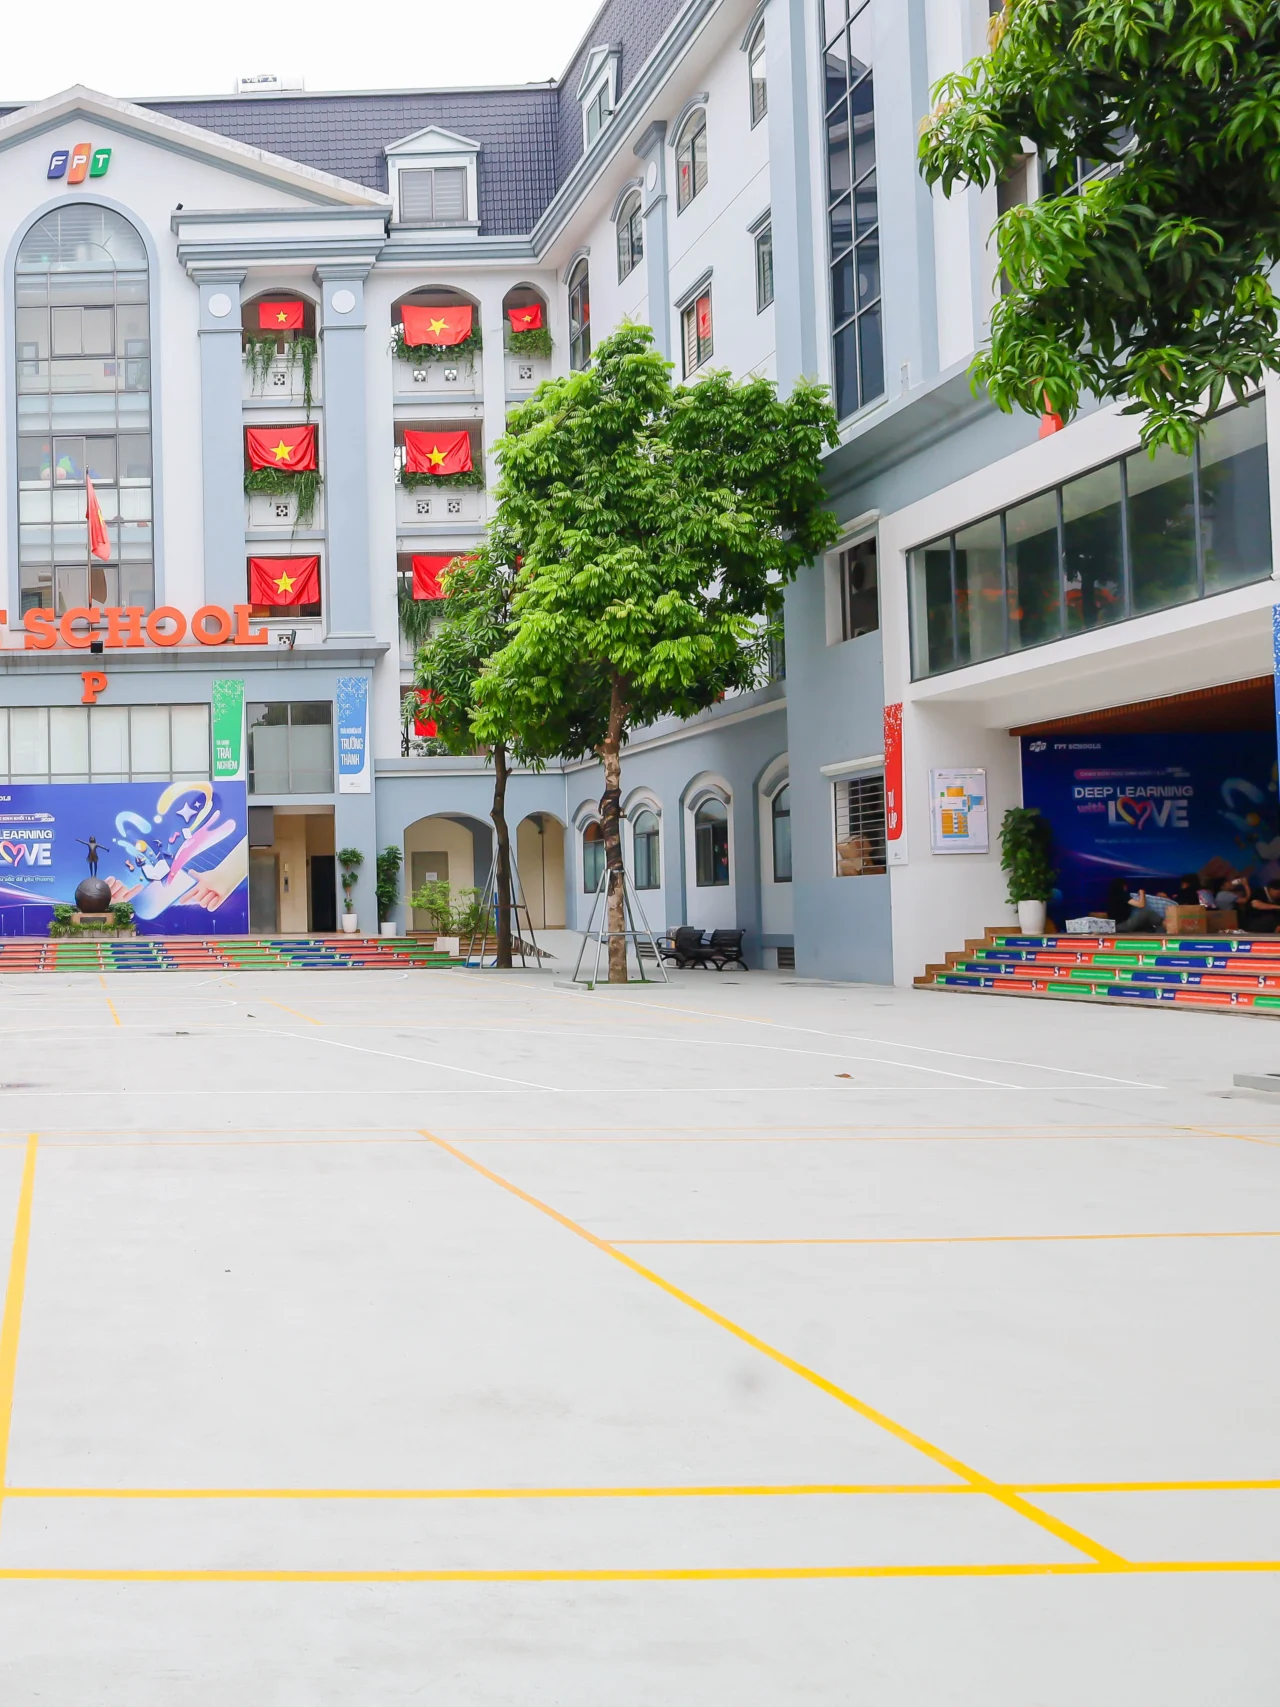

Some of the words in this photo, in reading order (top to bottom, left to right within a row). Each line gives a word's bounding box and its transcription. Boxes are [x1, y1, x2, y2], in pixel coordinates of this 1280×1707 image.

[24, 604, 268, 650] SCHOOL
[81, 671, 107, 703] P
[341, 752, 359, 765] THÀNH
[1074, 787, 1113, 798] DEEP
[1117, 786, 1193, 797] LEARNING
[1077, 801, 1106, 813] with
[1098, 940, 1103, 948] 5
[1076, 953, 1081, 962] 5
[1054, 967, 1059, 976] 5
[1258, 977, 1264, 987] 5
[1031, 981, 1037, 990] 5
[1231, 993, 1237, 1004] 5
